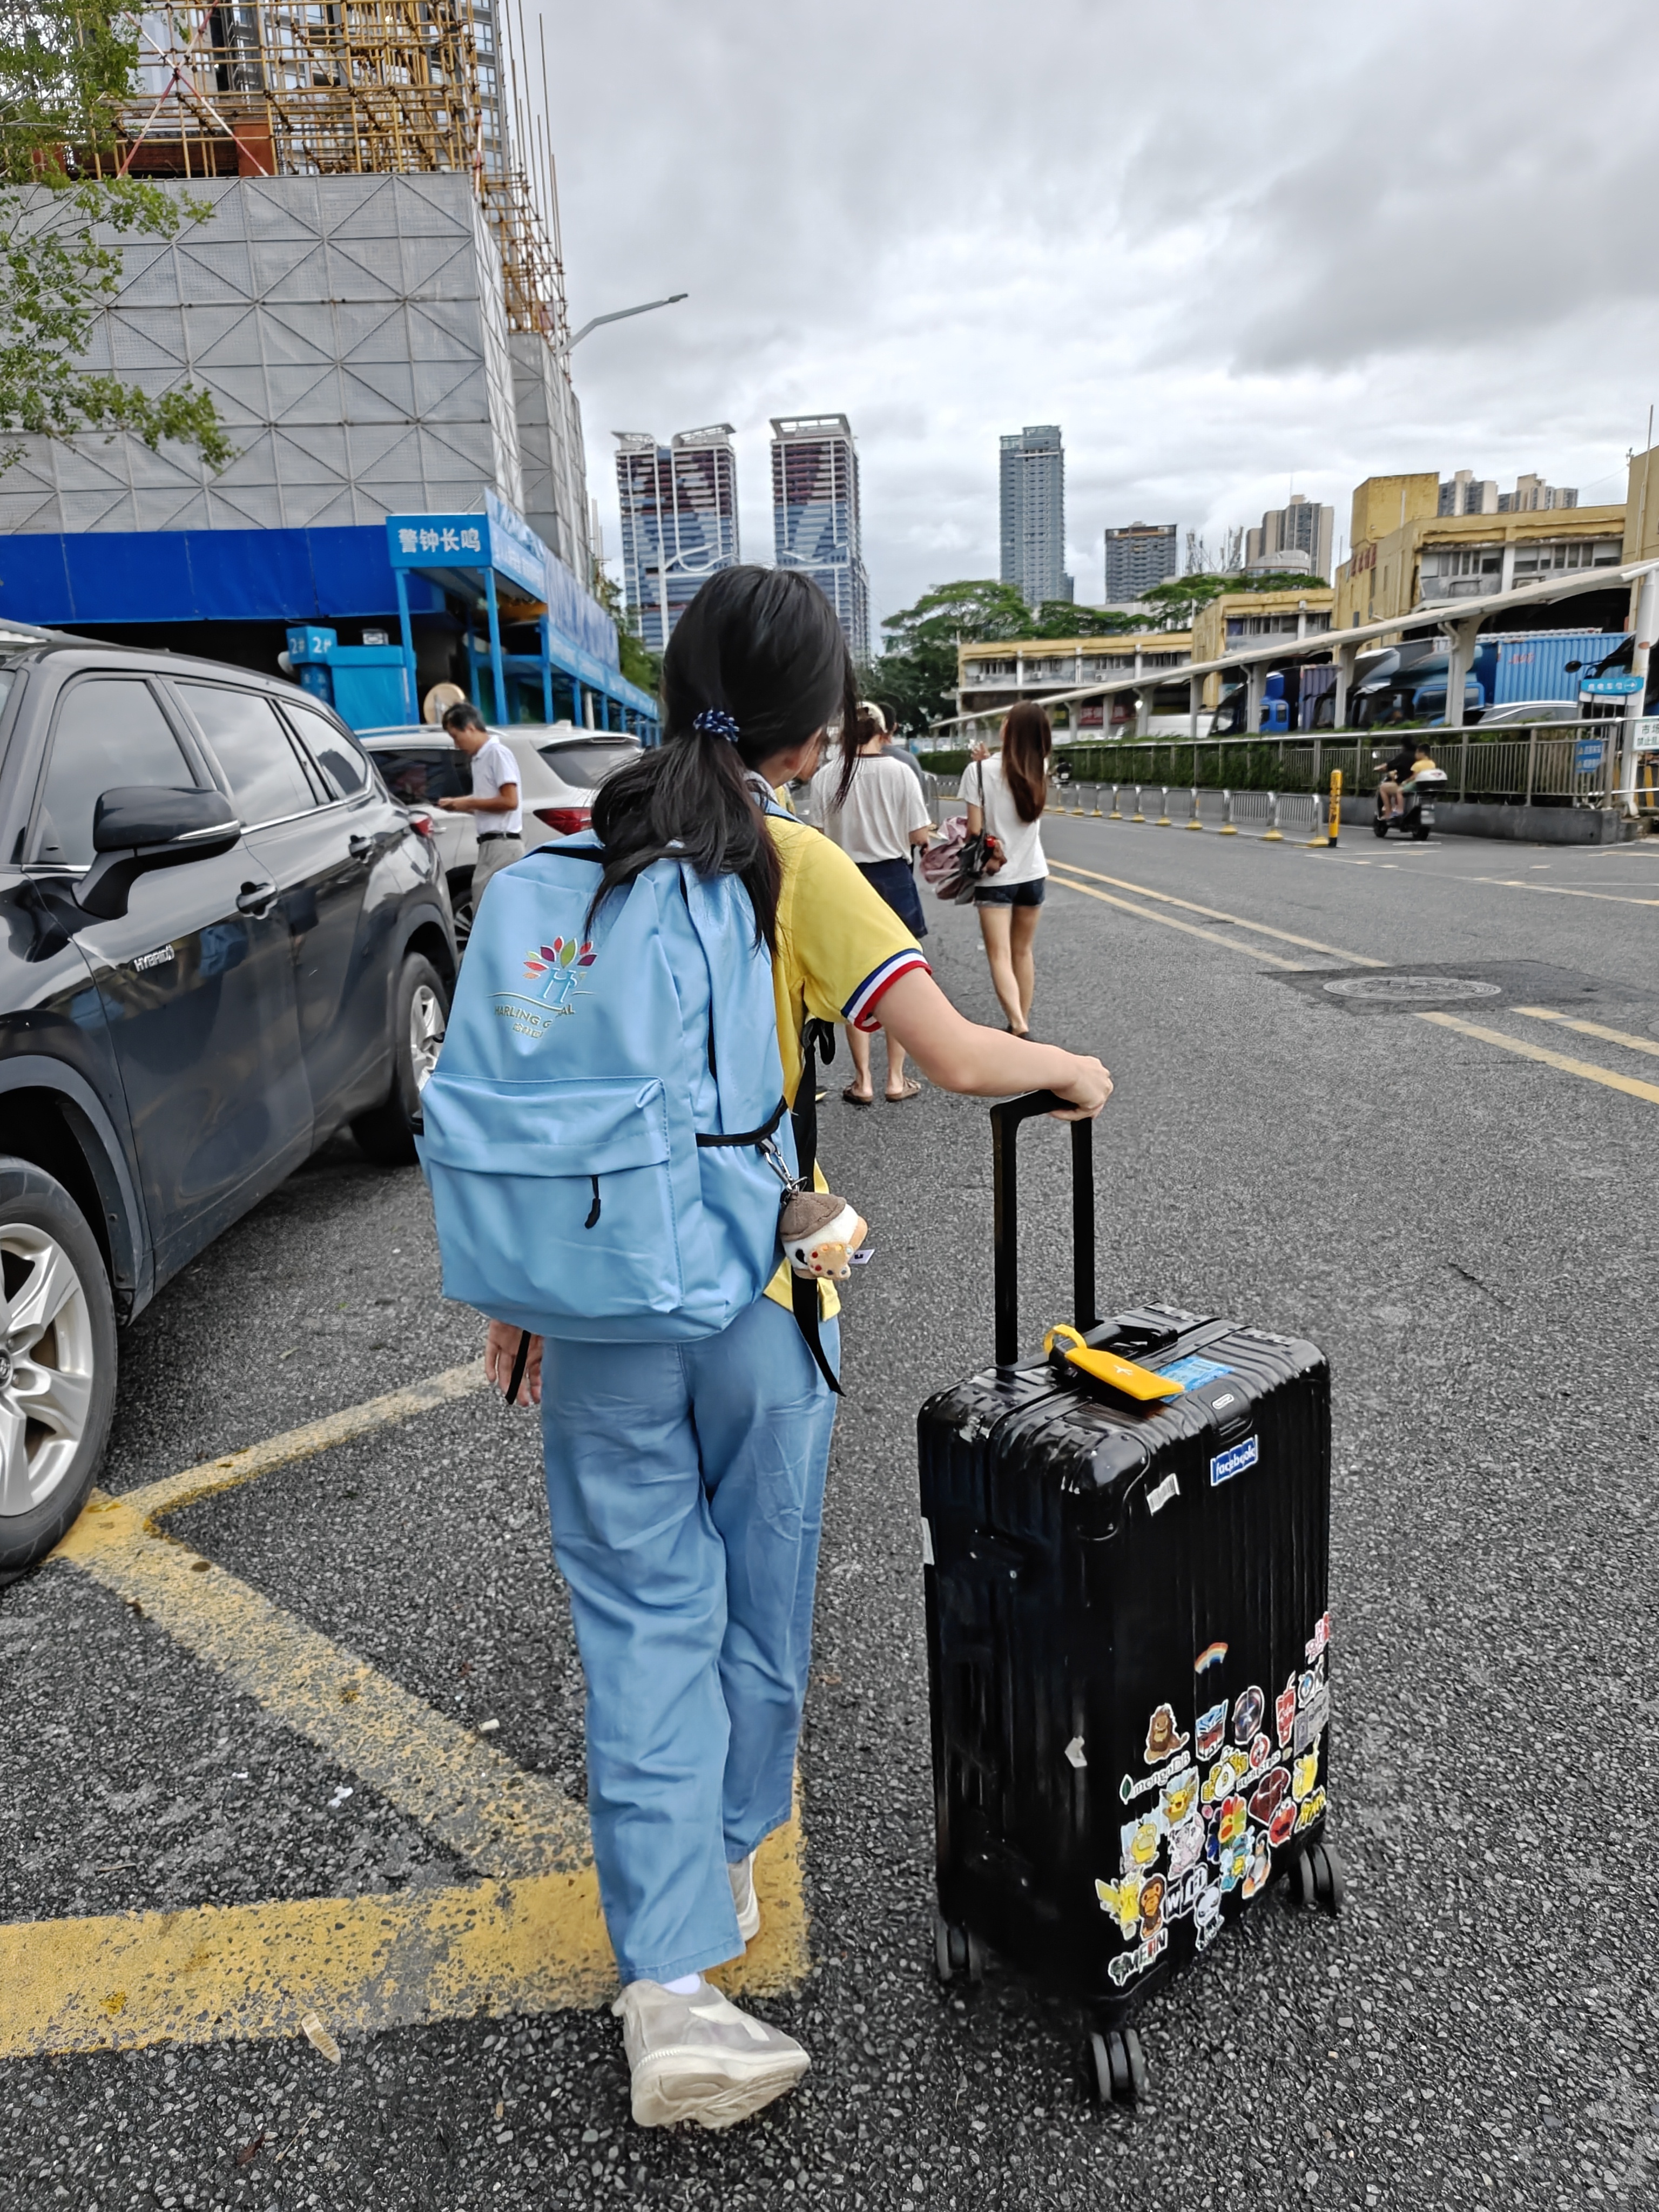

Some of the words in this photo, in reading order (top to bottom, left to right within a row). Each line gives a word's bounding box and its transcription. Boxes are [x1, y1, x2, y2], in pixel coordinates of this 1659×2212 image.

[398, 528, 481, 553] 警钟长鸣
[495, 1005, 541, 1026] HARLING
[1216, 1445, 1256, 1476] facebook
[1134, 1753, 1189, 1796] mongoDB
